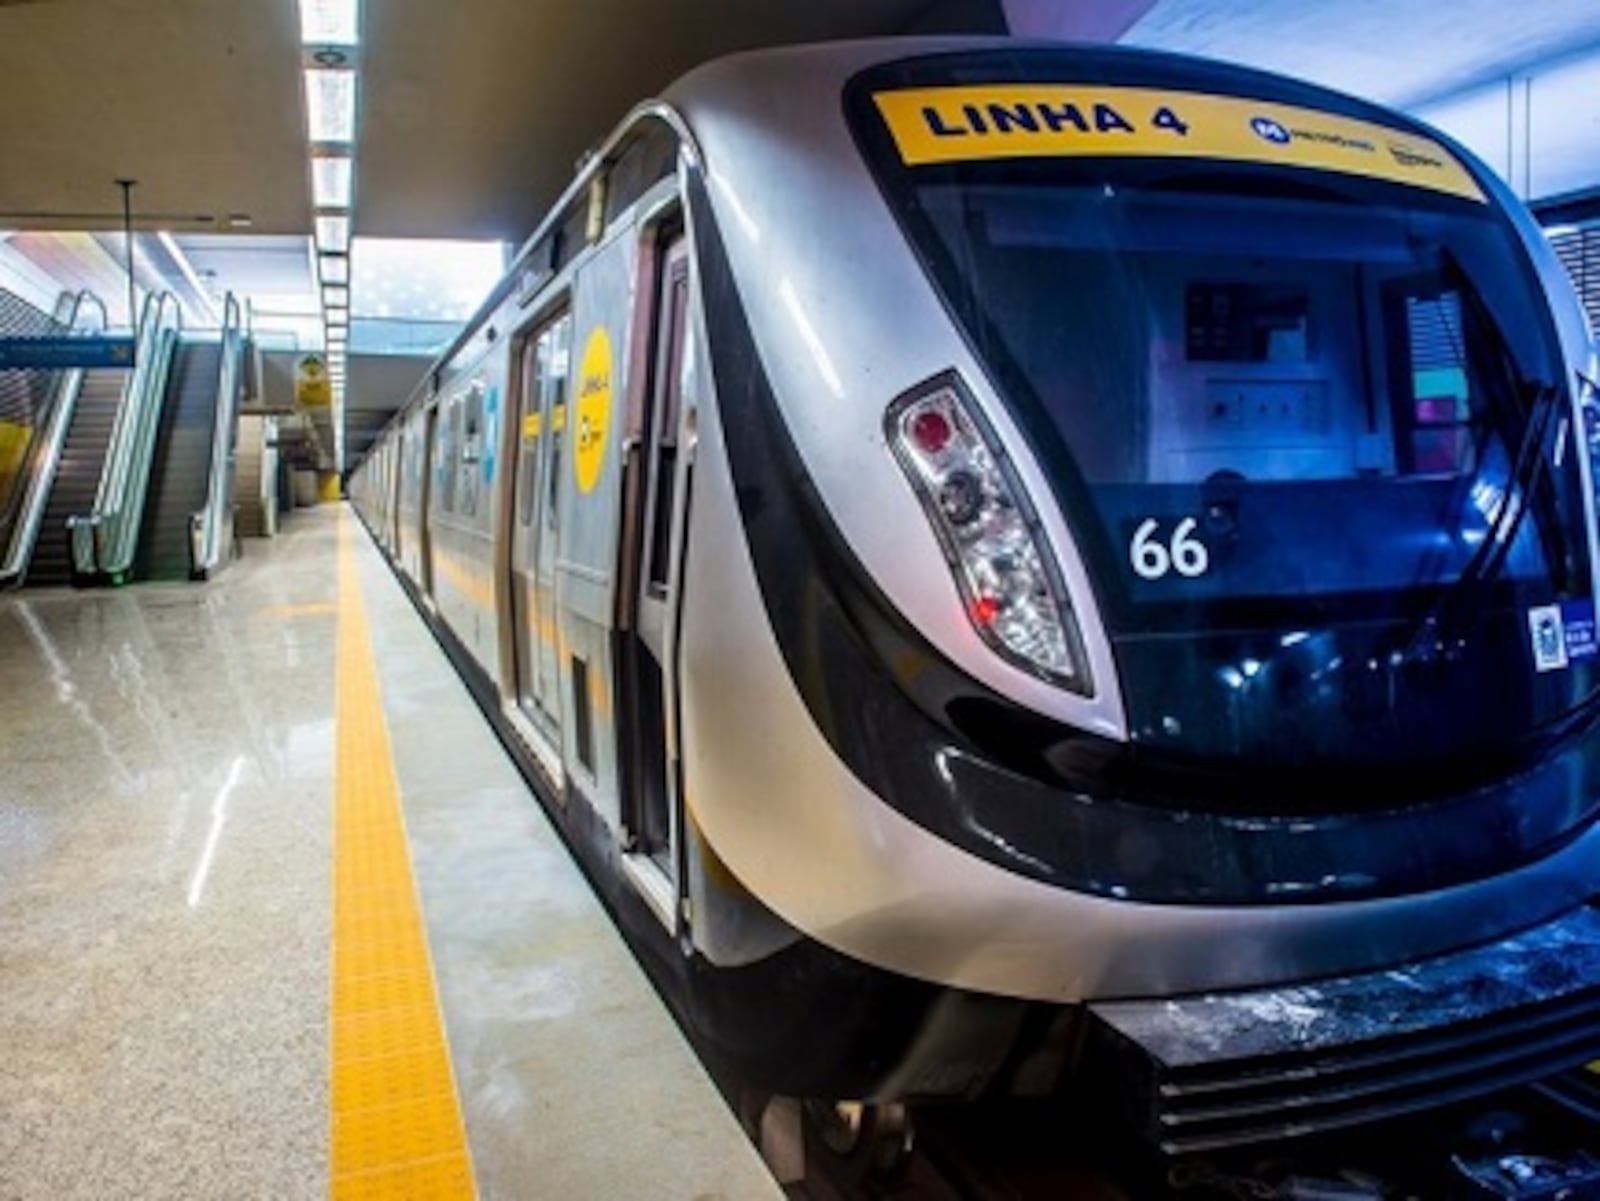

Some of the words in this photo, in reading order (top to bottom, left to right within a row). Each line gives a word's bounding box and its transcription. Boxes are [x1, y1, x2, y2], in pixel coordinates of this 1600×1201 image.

[921, 103, 1135, 136] LINHA
[1151, 106, 1189, 136] 4
[1130, 517, 1208, 580] 66
